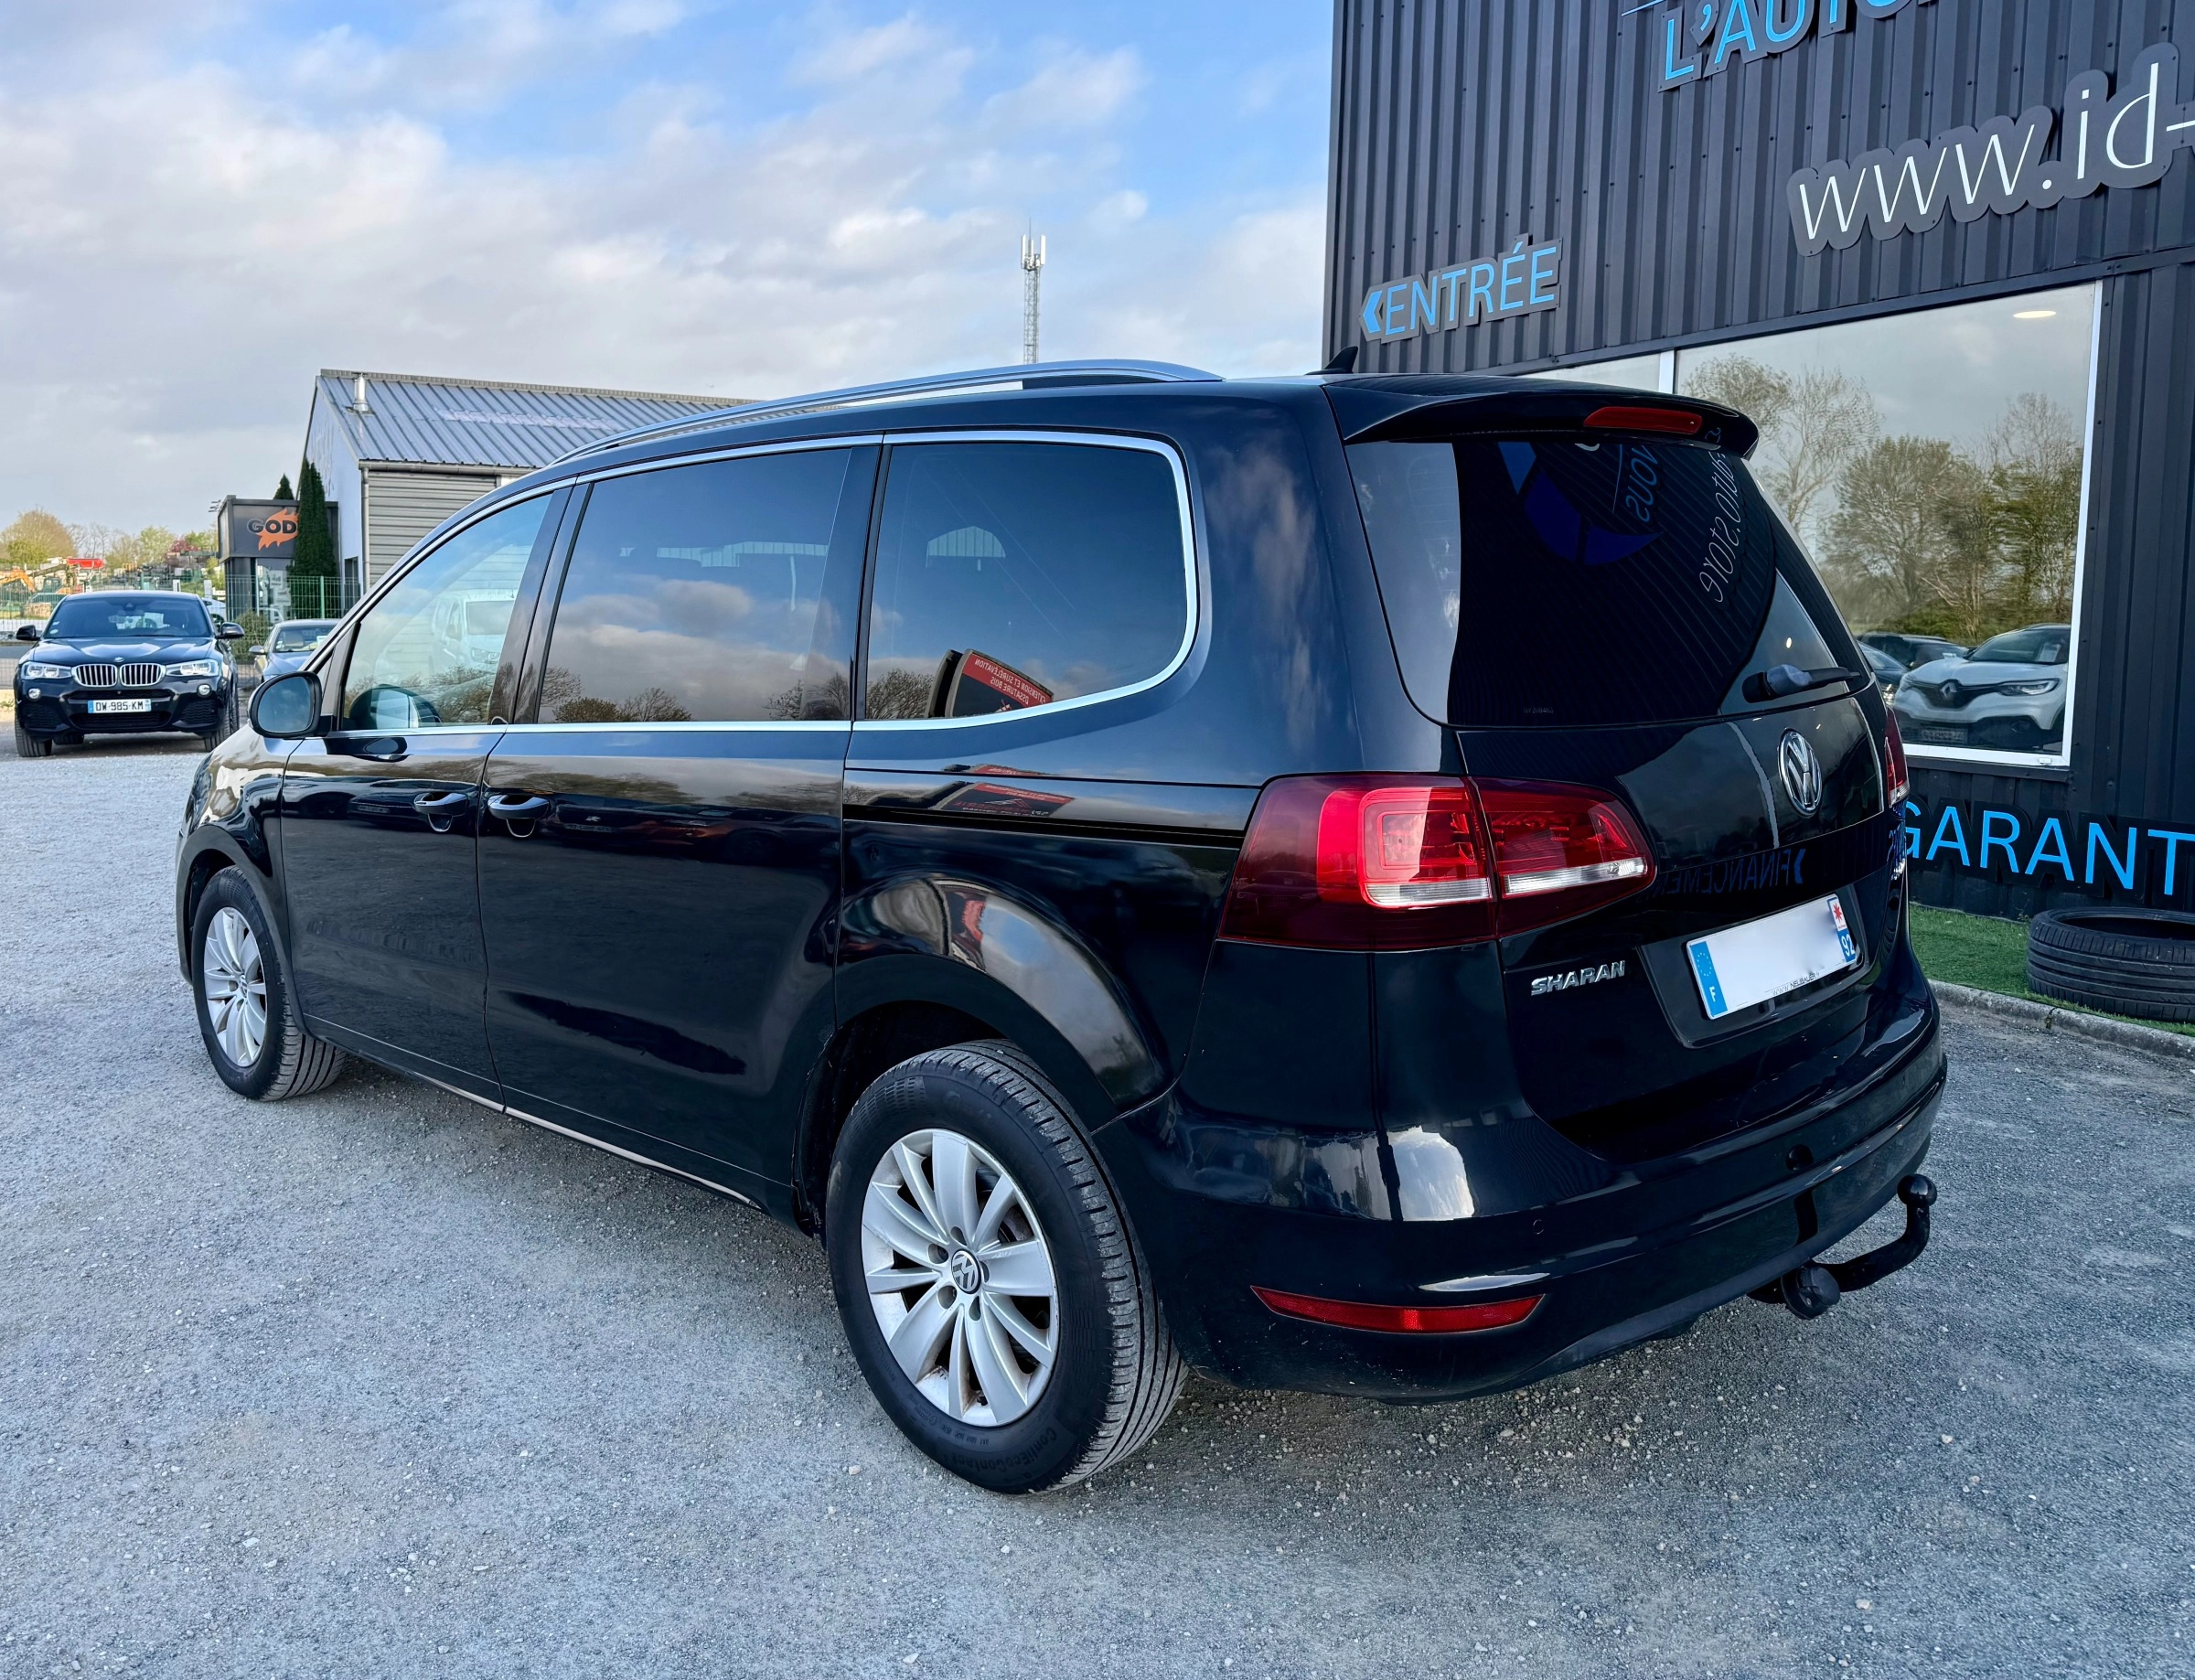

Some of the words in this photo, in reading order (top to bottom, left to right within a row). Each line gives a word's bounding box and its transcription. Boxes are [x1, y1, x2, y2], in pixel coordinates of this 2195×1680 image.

[1665, 0, 1903, 80] L’AU
[1385, 241, 1557, 336] ENTRÉE
[1841, 934, 1855, 957] 92
[1531, 960, 1625, 995] SHARAN
[1708, 986, 1717, 1002] F
